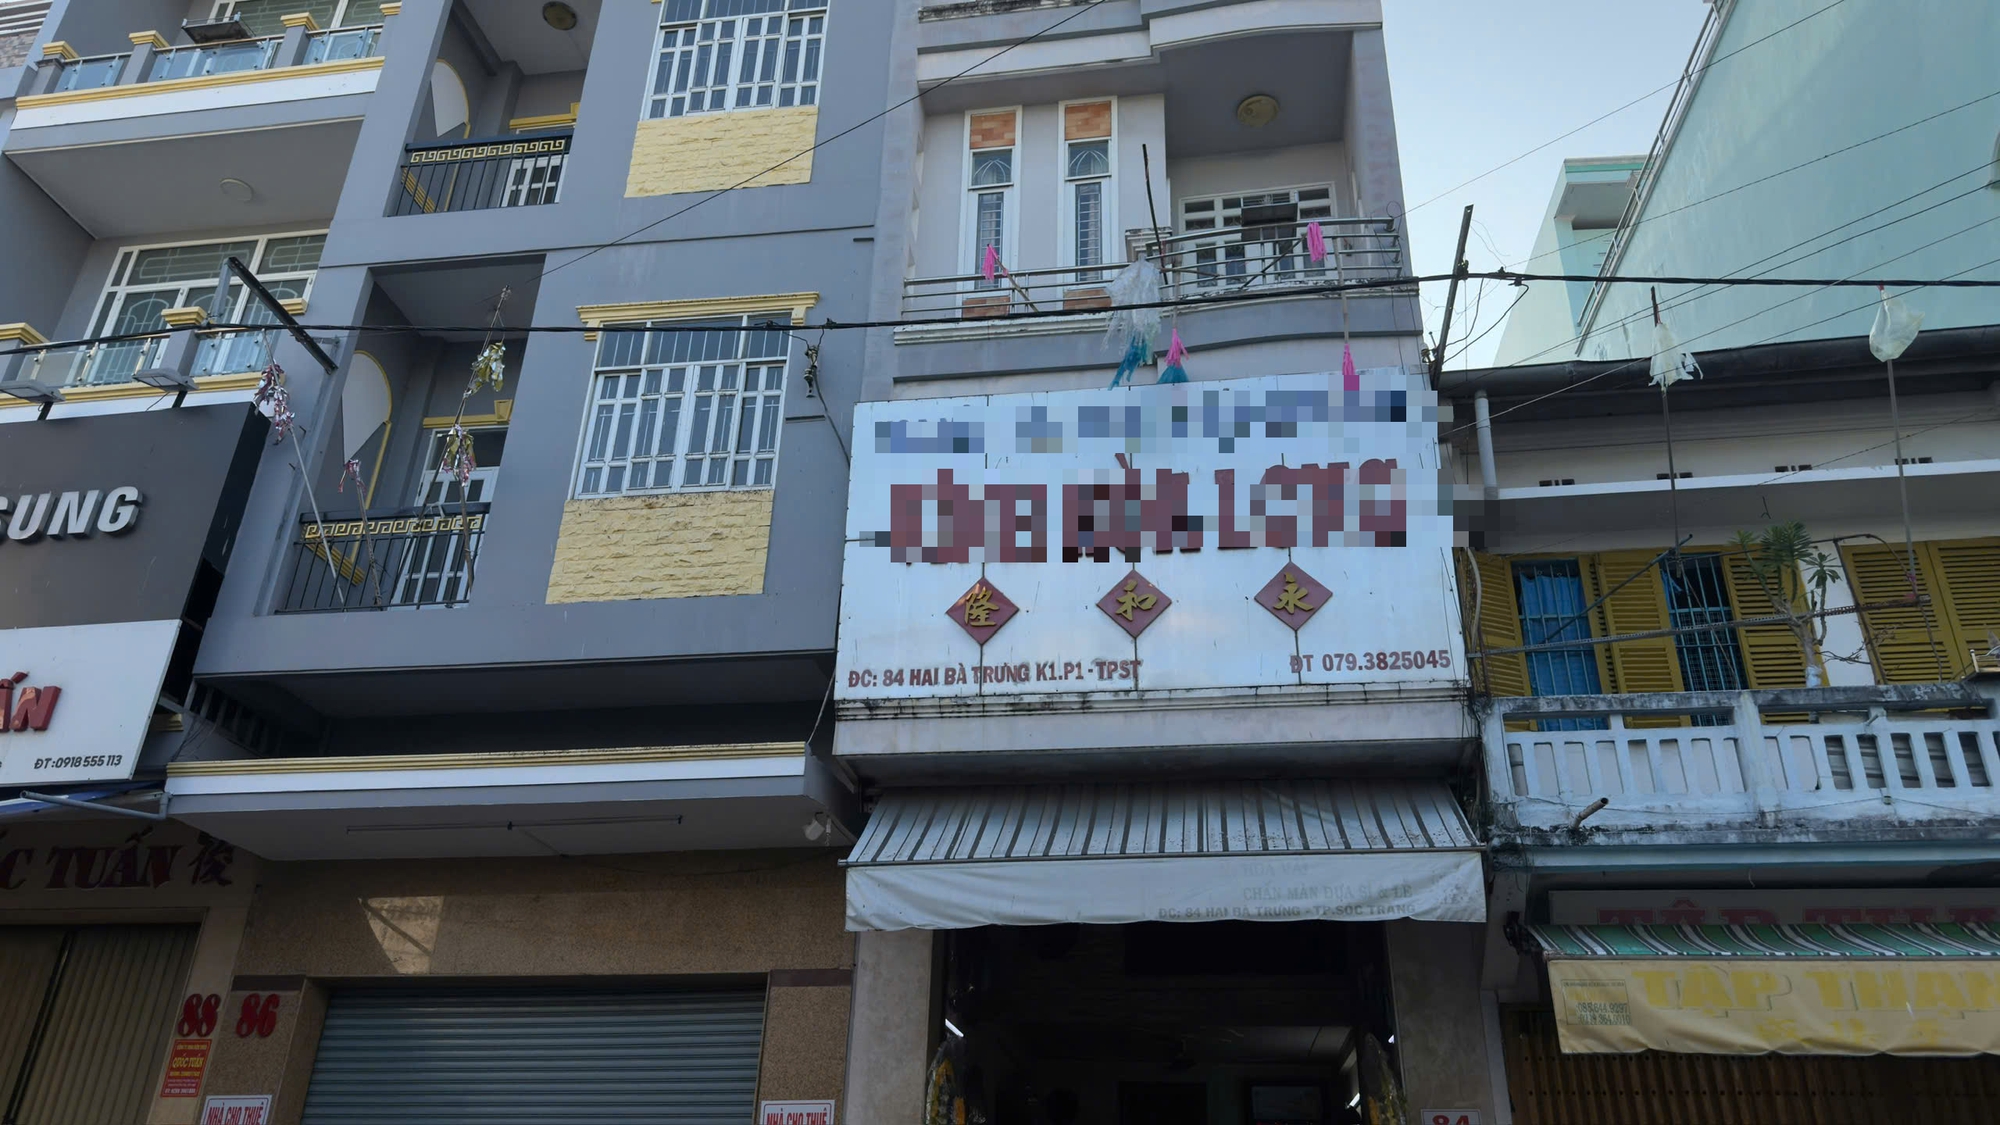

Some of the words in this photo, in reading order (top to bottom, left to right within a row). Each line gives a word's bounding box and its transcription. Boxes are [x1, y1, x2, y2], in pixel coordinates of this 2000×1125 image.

[964, 587, 999, 627] 隆
[1115, 580, 1157, 621] 和
[1273, 573, 1313, 613] 永
[848, 669, 878, 688] ĐC:
[882, 669, 904, 687] 84
[909, 668, 939, 687] HAI
[943, 662, 967, 686] BÀ
[971, 661, 1030, 685] TRƯNG
[1289, 655, 1314, 674] ĐT
[1322, 650, 1451, 672] 079.3825045
[1185, 907, 1201, 918] 84
[1206, 906, 1228, 918] HAI
[178, 993, 221, 1038] 88
[236, 993, 280, 1038] 86
[206, 1102, 225, 1125] NHÀ
[225, 1107, 242, 1125] CHO
[243, 1101, 264, 1125] THUÊ
